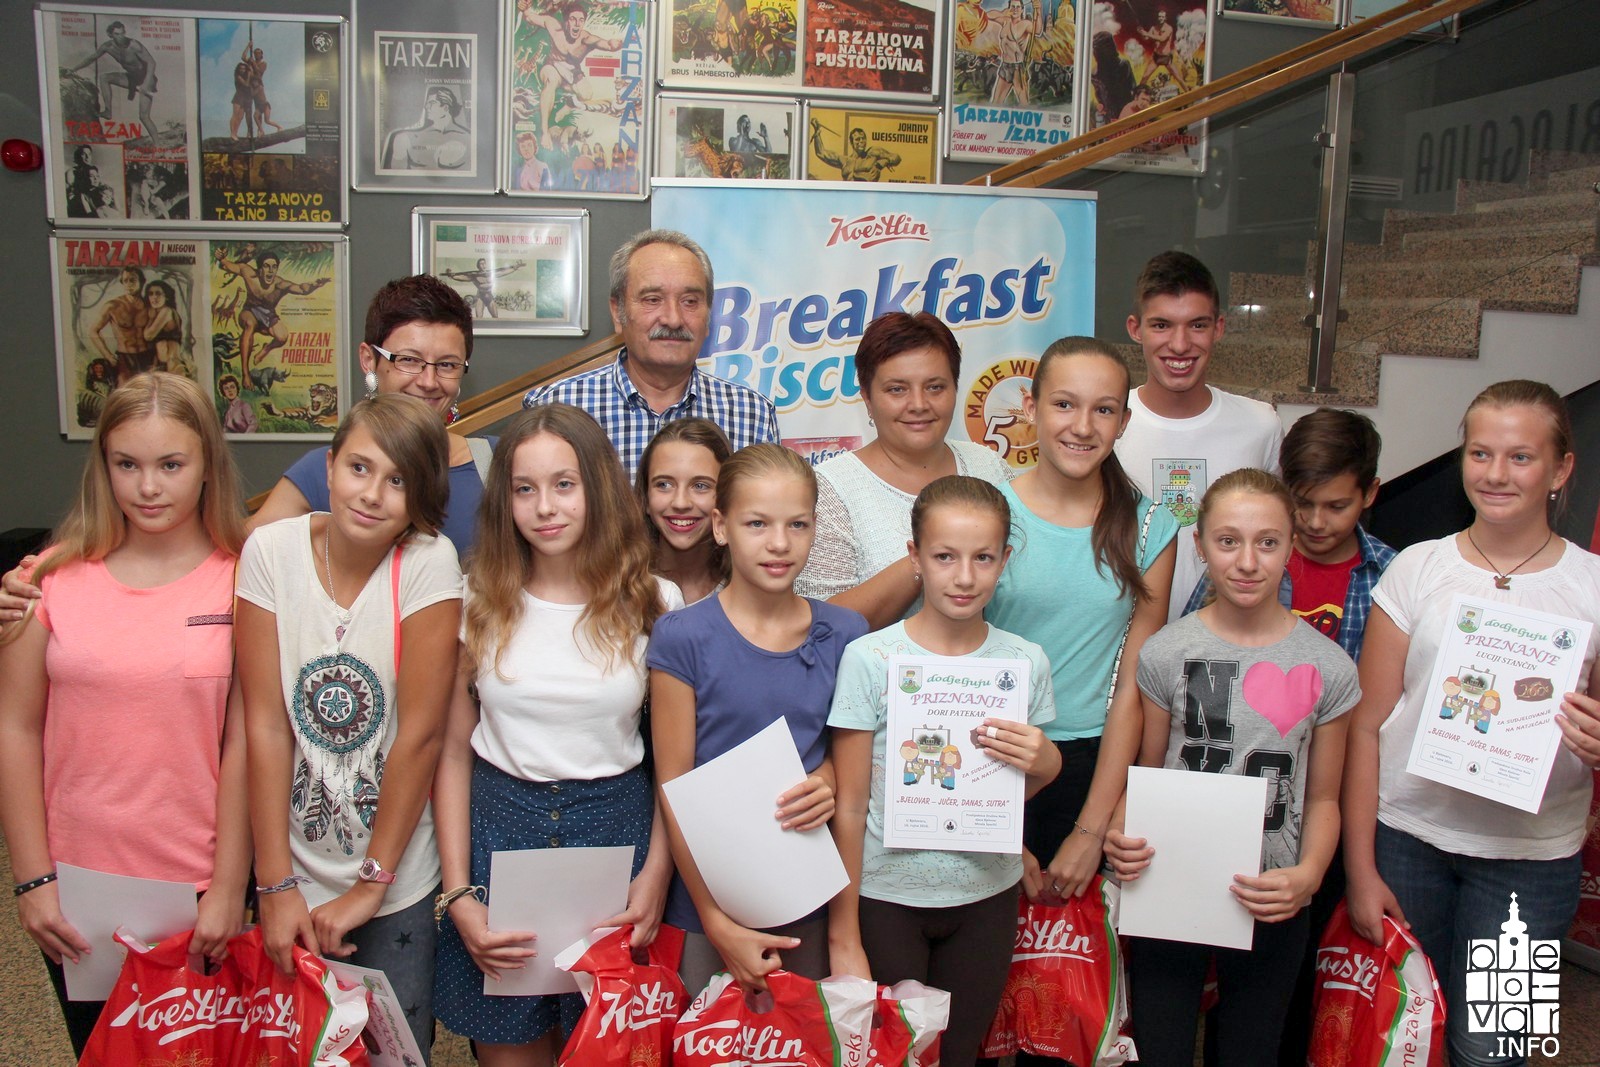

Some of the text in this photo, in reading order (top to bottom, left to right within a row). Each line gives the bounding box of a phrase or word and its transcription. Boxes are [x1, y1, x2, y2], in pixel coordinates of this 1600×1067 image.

[815, 29, 924, 50] TARZANOVA
[379, 40, 471, 69] TARZAN
[815, 53, 924, 73] PUSTOLOVINA
[671, 68, 741, 79] BRUS HAMBERSTON
[954, 102, 1043, 128] TARZANOV
[64, 120, 142, 140] TARZAN
[871, 131, 929, 145] WEISSMULLER
[897, 122, 929, 134] JOHNNY
[952, 132, 987, 141] ROBERT DAY
[1004, 125, 1070, 145] IZAZOV
[952, 143, 966, 152] JOCK
[223, 191, 324, 207] TARZANOVO
[215, 206, 332, 222] TAJNO BLAGO
[826, 213, 931, 249] Koestlin
[65, 241, 161, 268] TARZAN
[167, 244, 196, 253] NJEGOVA
[701, 256, 1053, 358] Breakfast
[288, 331, 332, 348] TARZAN
[967, 364, 1005, 418] MADE
[983, 415, 1018, 460] 5
[1464, 634, 1560, 667] PRIZNANJE
[1475, 650, 1538, 672] LUCIJI STANČIN
[910, 692, 1008, 709] PRIZNANJE
[1181, 658, 1239, 744] N
[927, 708, 986, 718] DORI PATEKAR
[1506, 709, 1551, 724] SUDJELOVANJE
[1404, 1019, 1419, 1040] za
